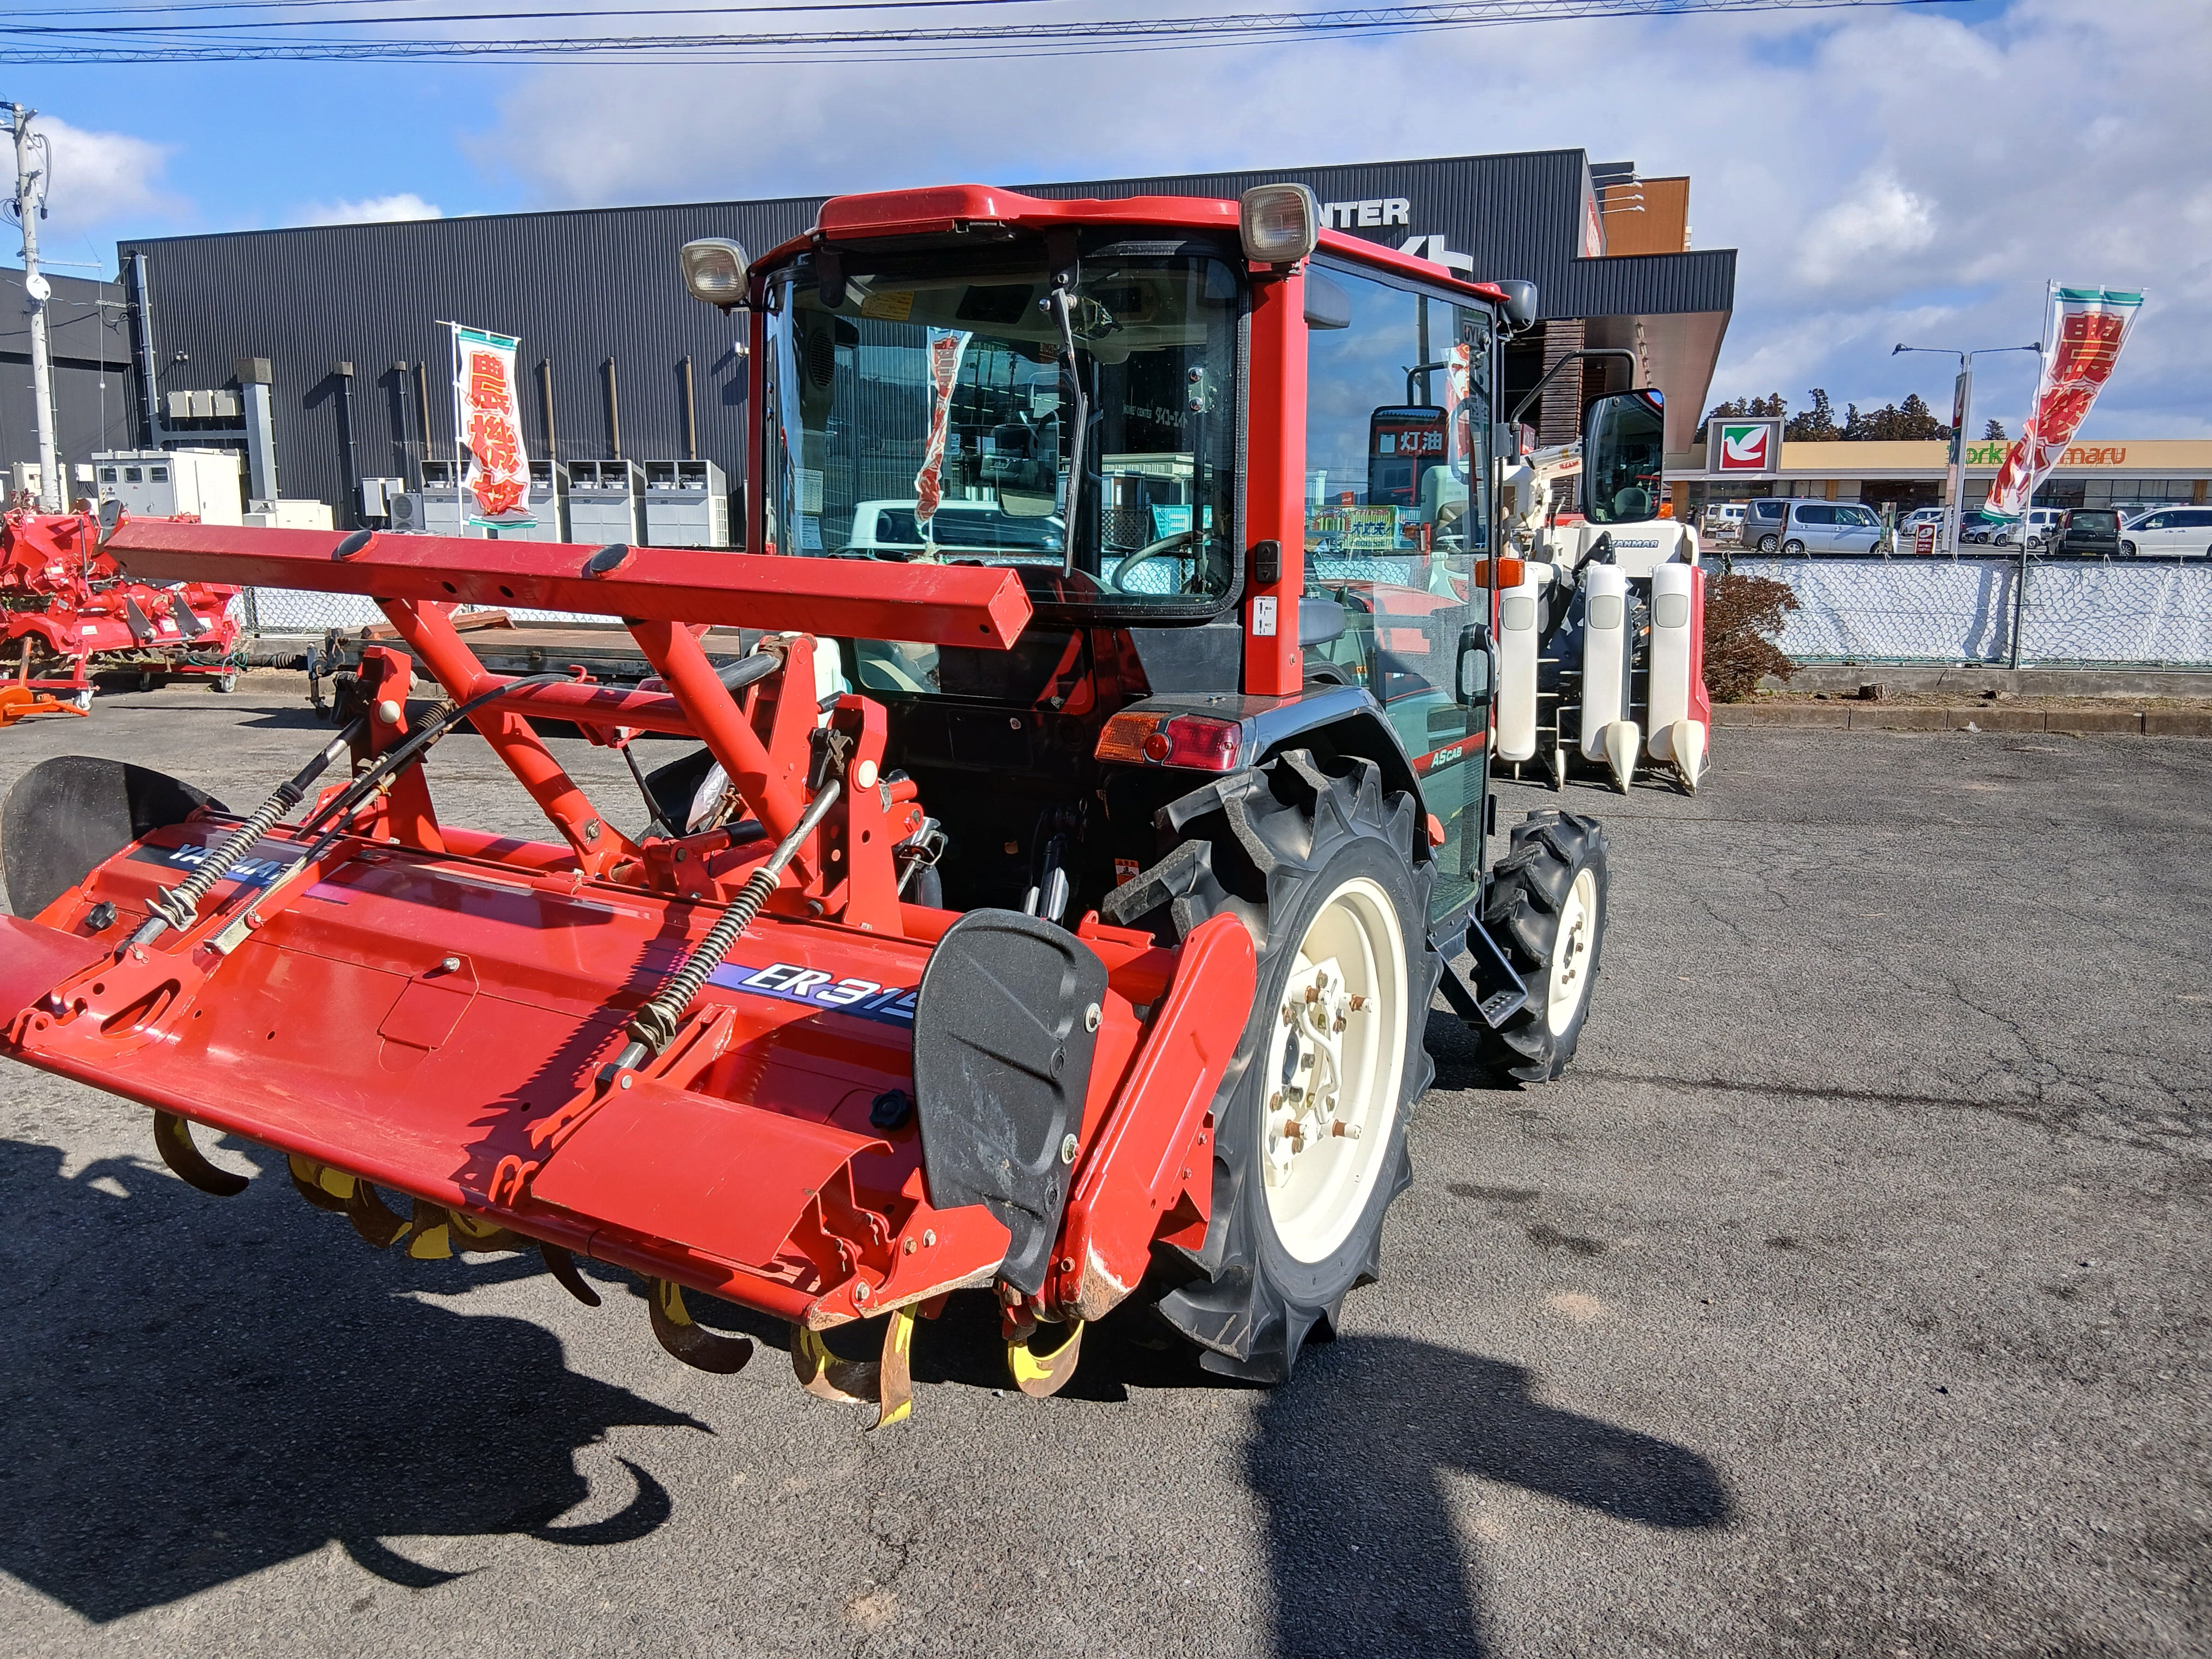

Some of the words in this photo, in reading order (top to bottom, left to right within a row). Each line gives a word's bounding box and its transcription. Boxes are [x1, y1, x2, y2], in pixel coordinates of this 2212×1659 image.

[1318, 198, 1410, 228] NTER
[1400, 430, 1442, 451] 灯油
[1965, 442, 2003, 464] ork
[169, 844, 282, 880] YAMA
